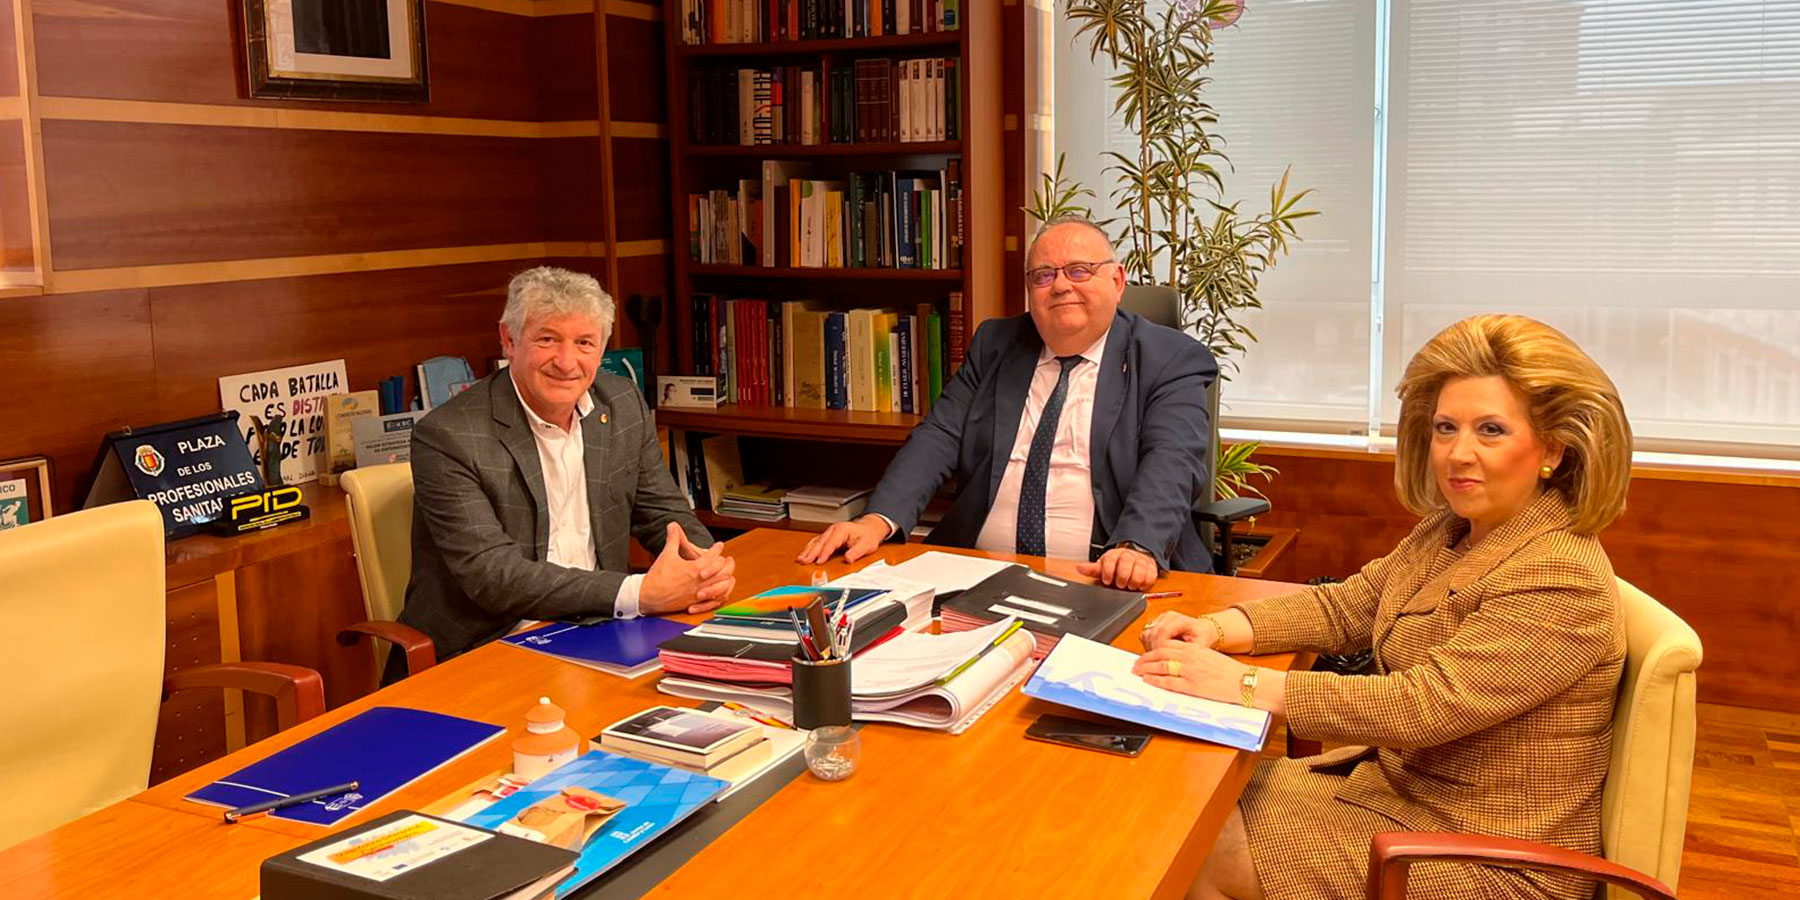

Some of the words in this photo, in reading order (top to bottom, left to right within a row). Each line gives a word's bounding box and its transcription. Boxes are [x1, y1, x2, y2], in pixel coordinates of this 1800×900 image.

[240, 380, 279, 403] CADA
[288, 371, 339, 397] BATALLA
[264, 402, 286, 419] ES
[290, 418, 305, 437] LA
[177, 434, 226, 455] PLAZA
[281, 440, 300, 460] DE
[177, 467, 192, 477] DE
[192, 461, 213, 474] LOS
[147, 471, 256, 506] PROFESIONALES
